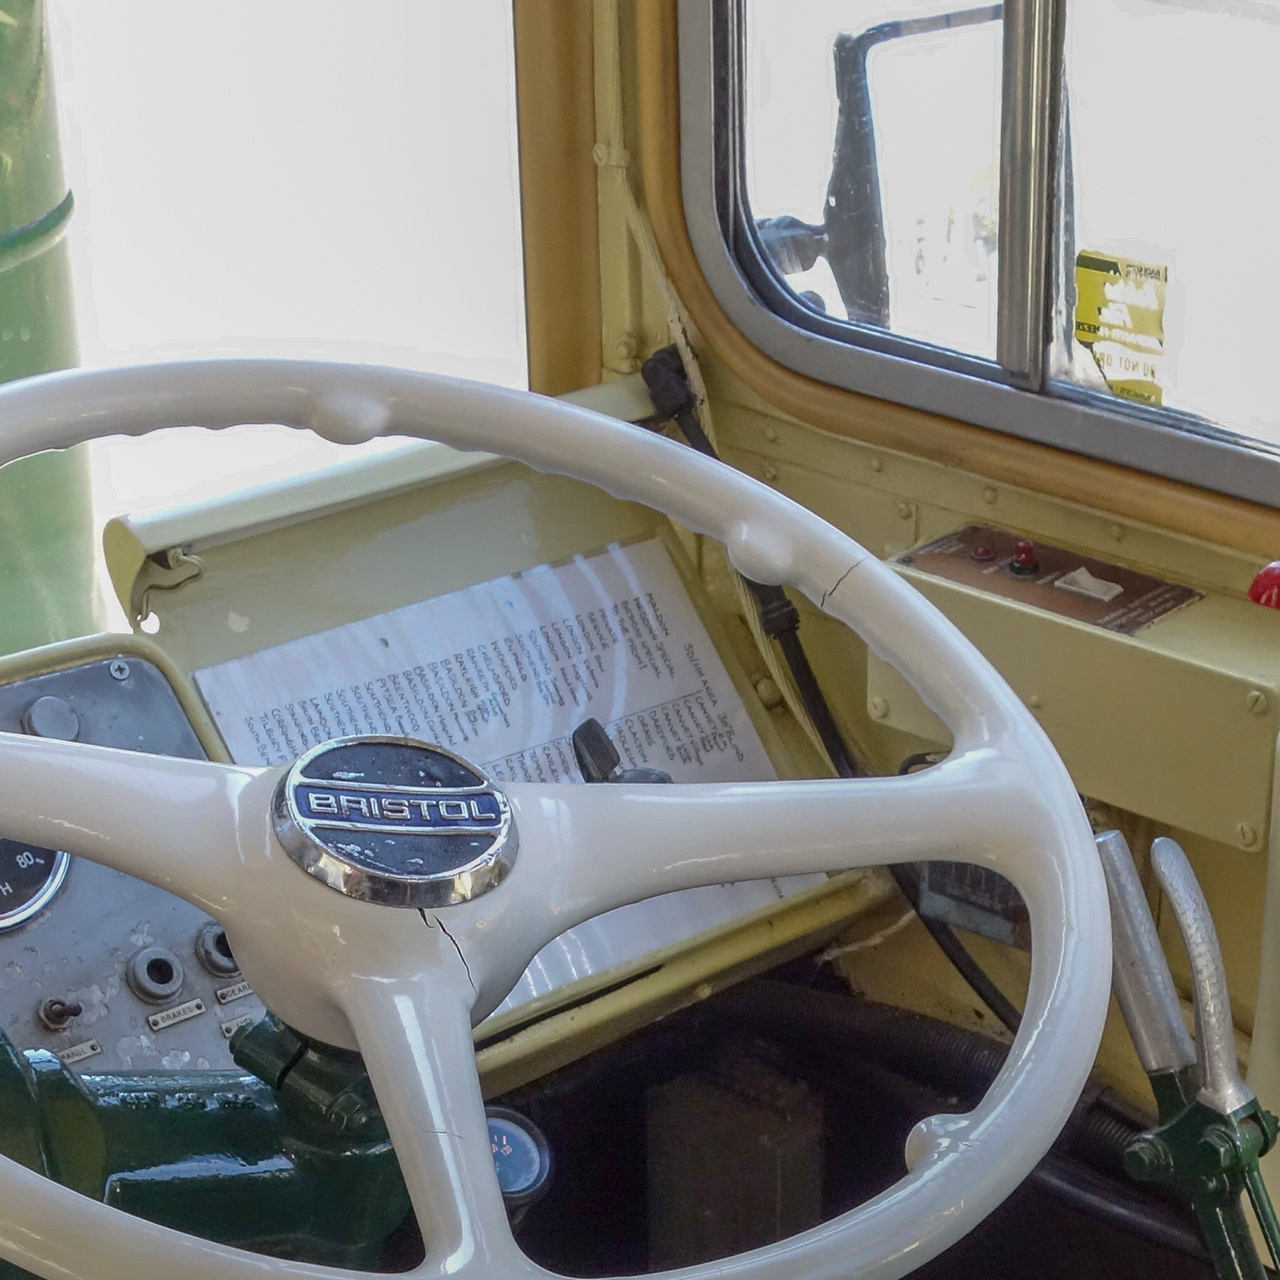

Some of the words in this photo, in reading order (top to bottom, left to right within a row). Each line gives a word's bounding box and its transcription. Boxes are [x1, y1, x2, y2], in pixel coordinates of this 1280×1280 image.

[537, 624, 562, 663] LONDON
[549, 620, 574, 660] LONDON
[560, 617, 585, 656] LONDON
[572, 613, 597, 652] LONDON
[585, 610, 610, 651] SERVICE
[596, 606, 620, 645] PRIVATE
[615, 616, 631, 636] THE
[631, 595, 660, 642] WEDDING
[654, 640, 678, 680] SPECIAL
[463, 646, 493, 692] RAWRETH
[488, 639, 522, 691] WICKFORD
[501, 636, 532, 682] ENFIELD
[512, 631, 543, 680] SOUTHEND
[524, 628, 556, 676] SOUTHEND
[639, 639, 664, 680] SPECIAL
[374, 676, 401, 714] PITSEA
[399, 668, 434, 720] BASILDON
[425, 660, 460, 712] BASILDON
[438, 657, 473, 709] BASILDON
[451, 651, 483, 699] RAYLEIGH
[474, 642, 515, 707] CHELMSFORD
[361, 680, 396, 733] SOUTHEND
[384, 671, 425, 732] BRENTWOOD
[411, 663, 445, 713] BASILDON
[434, 713, 458, 747] Hospital
[670, 701, 694, 740] CANVEY
[682, 697, 705, 735] CANVEY
[694, 694, 717, 732] CANVEY
[242, 714, 264, 746] SOUTH
[257, 712, 284, 755] TILBURY
[623, 717, 651, 763] CLACTON
[635, 713, 656, 746] GRAYS
[658, 705, 683, 744] CANVEY
[308, 791, 497, 822] BRISTOL
[15, 850, 35, 869] 80
[158, 1004, 195, 1023] BRAKES
